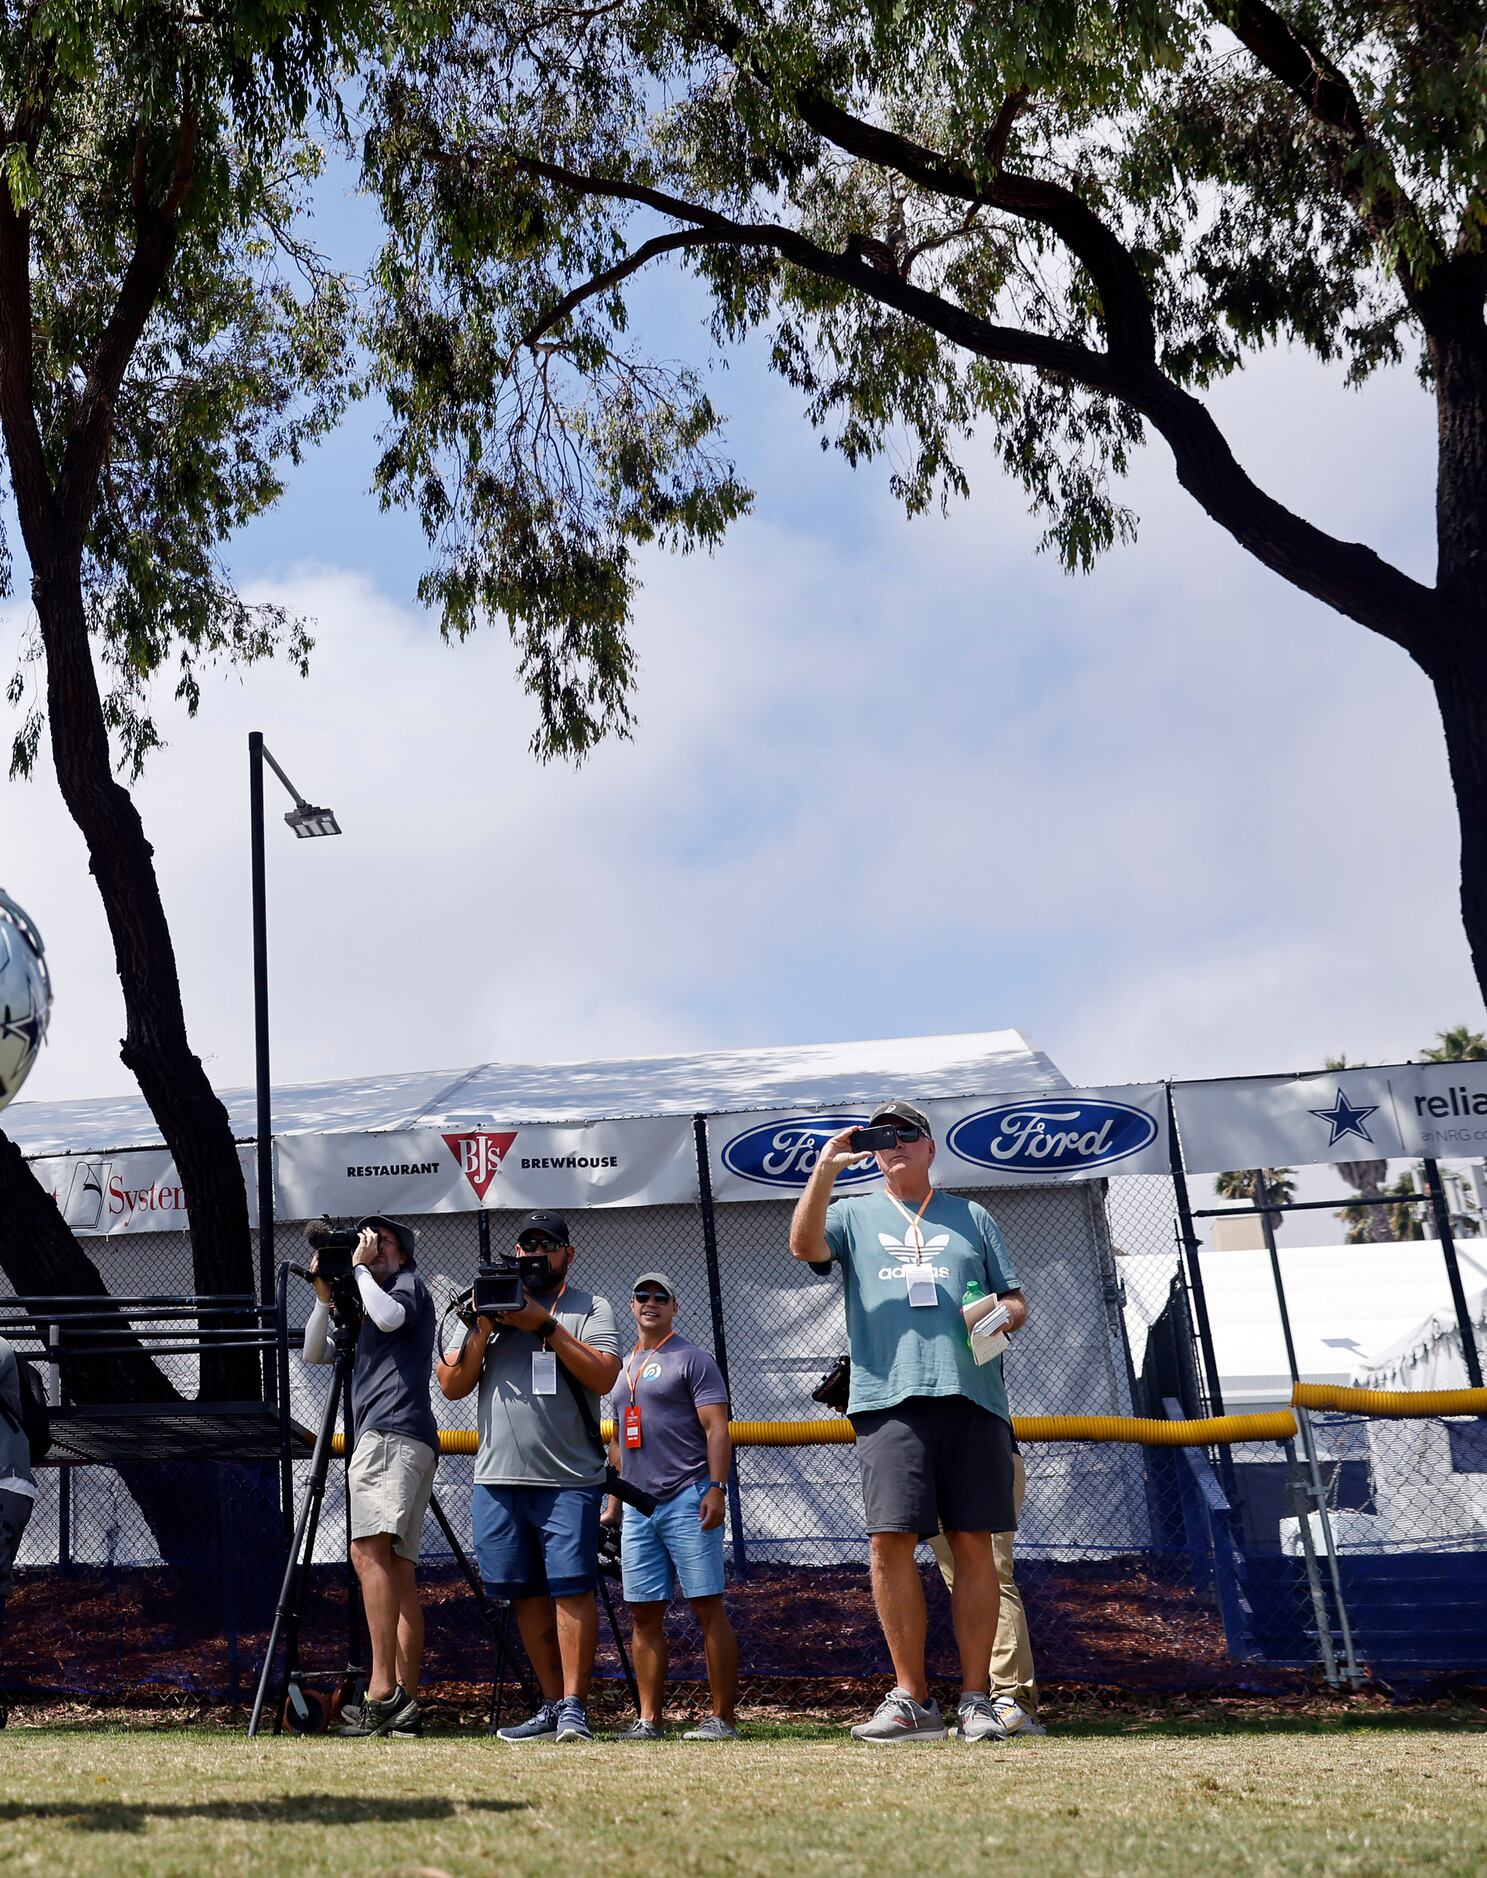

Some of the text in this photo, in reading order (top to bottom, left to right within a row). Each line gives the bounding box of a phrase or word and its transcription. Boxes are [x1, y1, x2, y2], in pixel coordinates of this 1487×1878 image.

[990, 1111, 1114, 1160] Ford
[1436, 1128, 1471, 1141] NRG
[521, 1156, 618, 1169] BREWHOUSE
[346, 1162, 440, 1178] RESTAURANT
